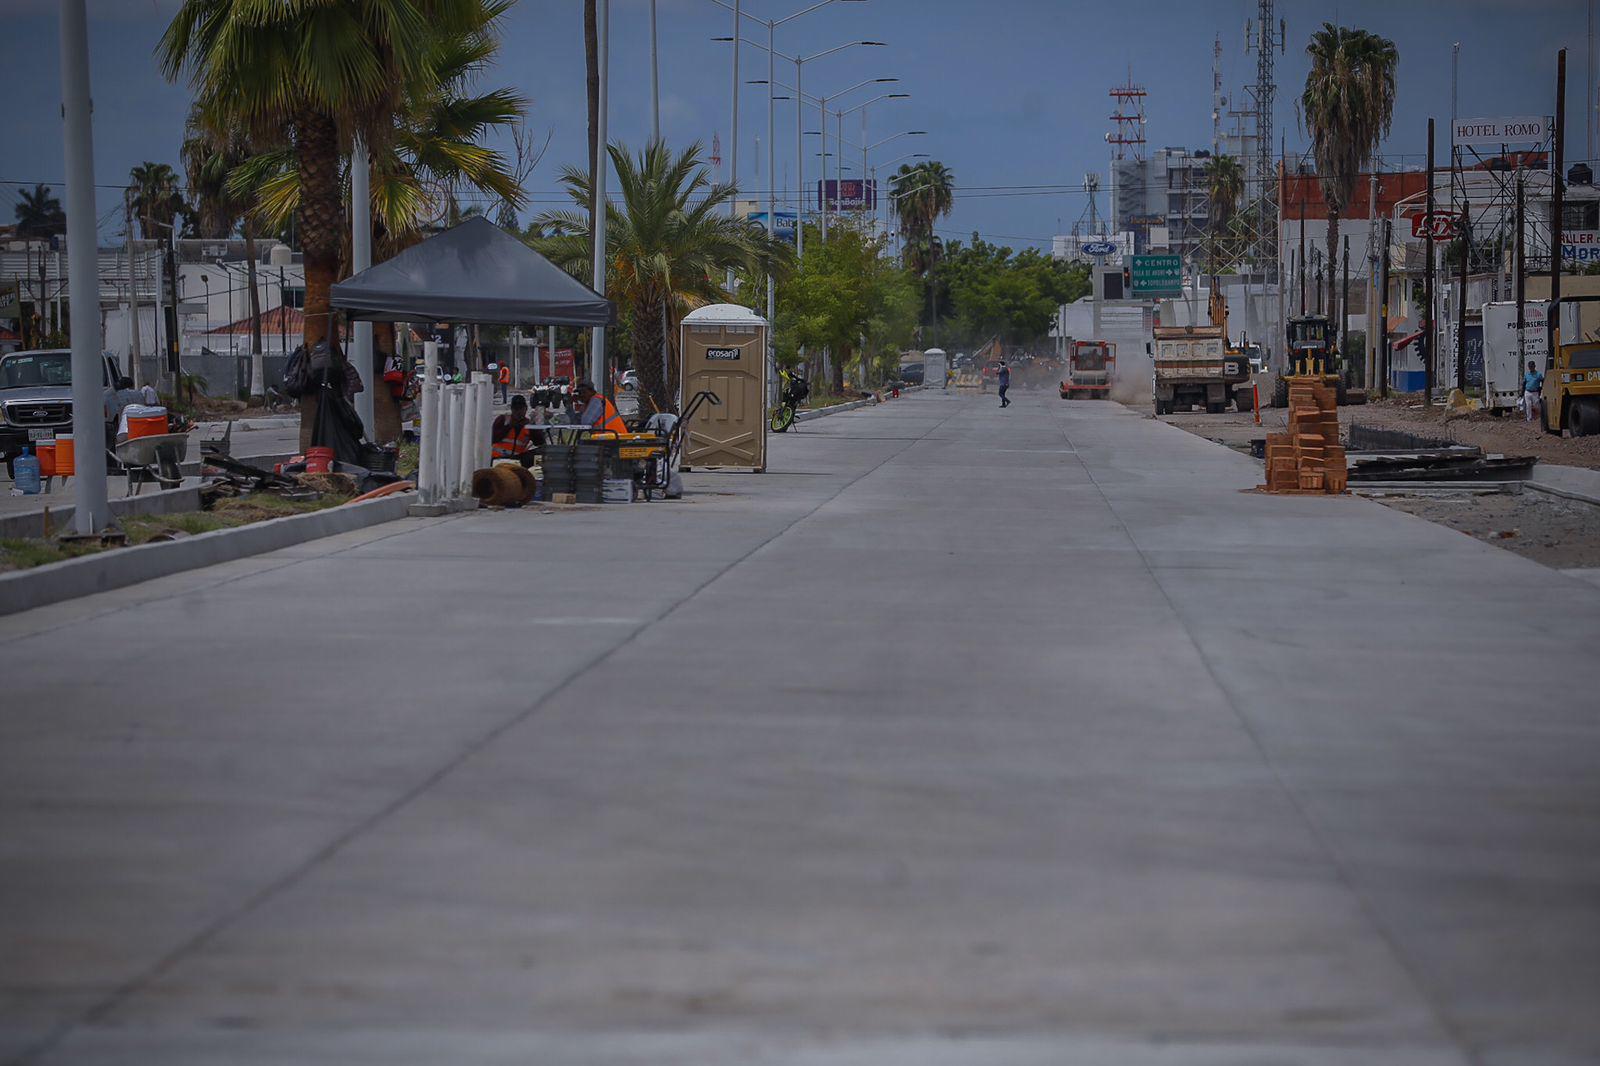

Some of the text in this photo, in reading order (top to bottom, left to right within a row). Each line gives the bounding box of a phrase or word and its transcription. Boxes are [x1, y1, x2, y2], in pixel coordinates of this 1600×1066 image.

[1457, 122, 1540, 137] HOTEL ROMO
[1559, 233, 1593, 244] ALLER
[1088, 243, 1110, 253] Ford
[1144, 259, 1179, 267] CENTRO
